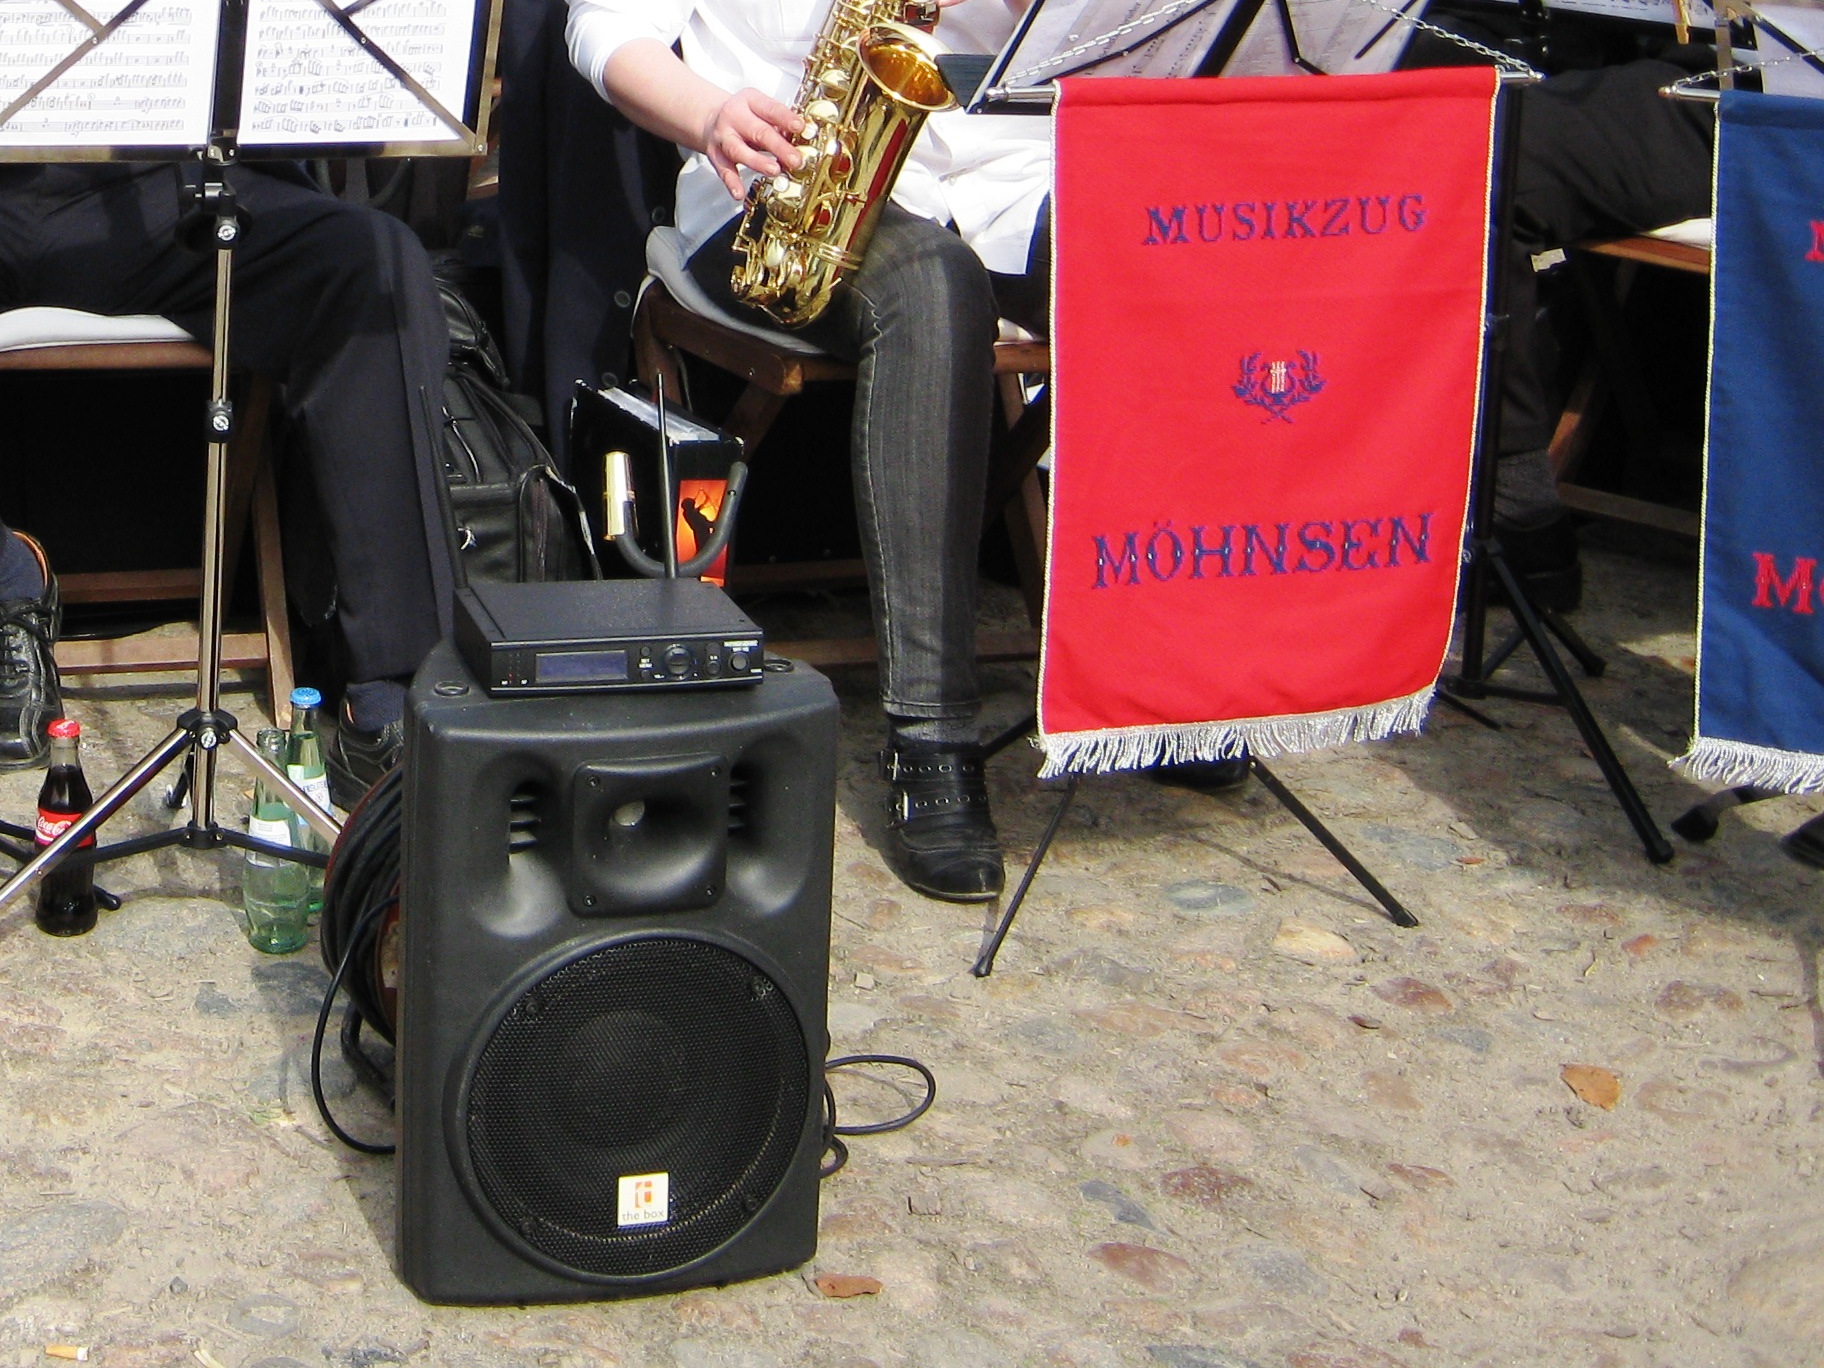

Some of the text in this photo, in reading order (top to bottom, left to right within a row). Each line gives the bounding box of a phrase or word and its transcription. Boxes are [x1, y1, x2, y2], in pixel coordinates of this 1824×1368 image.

[1142, 193, 1428, 246] MUSIKZUG
[1091, 511, 1435, 590] MÖHNSEN
[622, 1209, 664, 1221] the box
